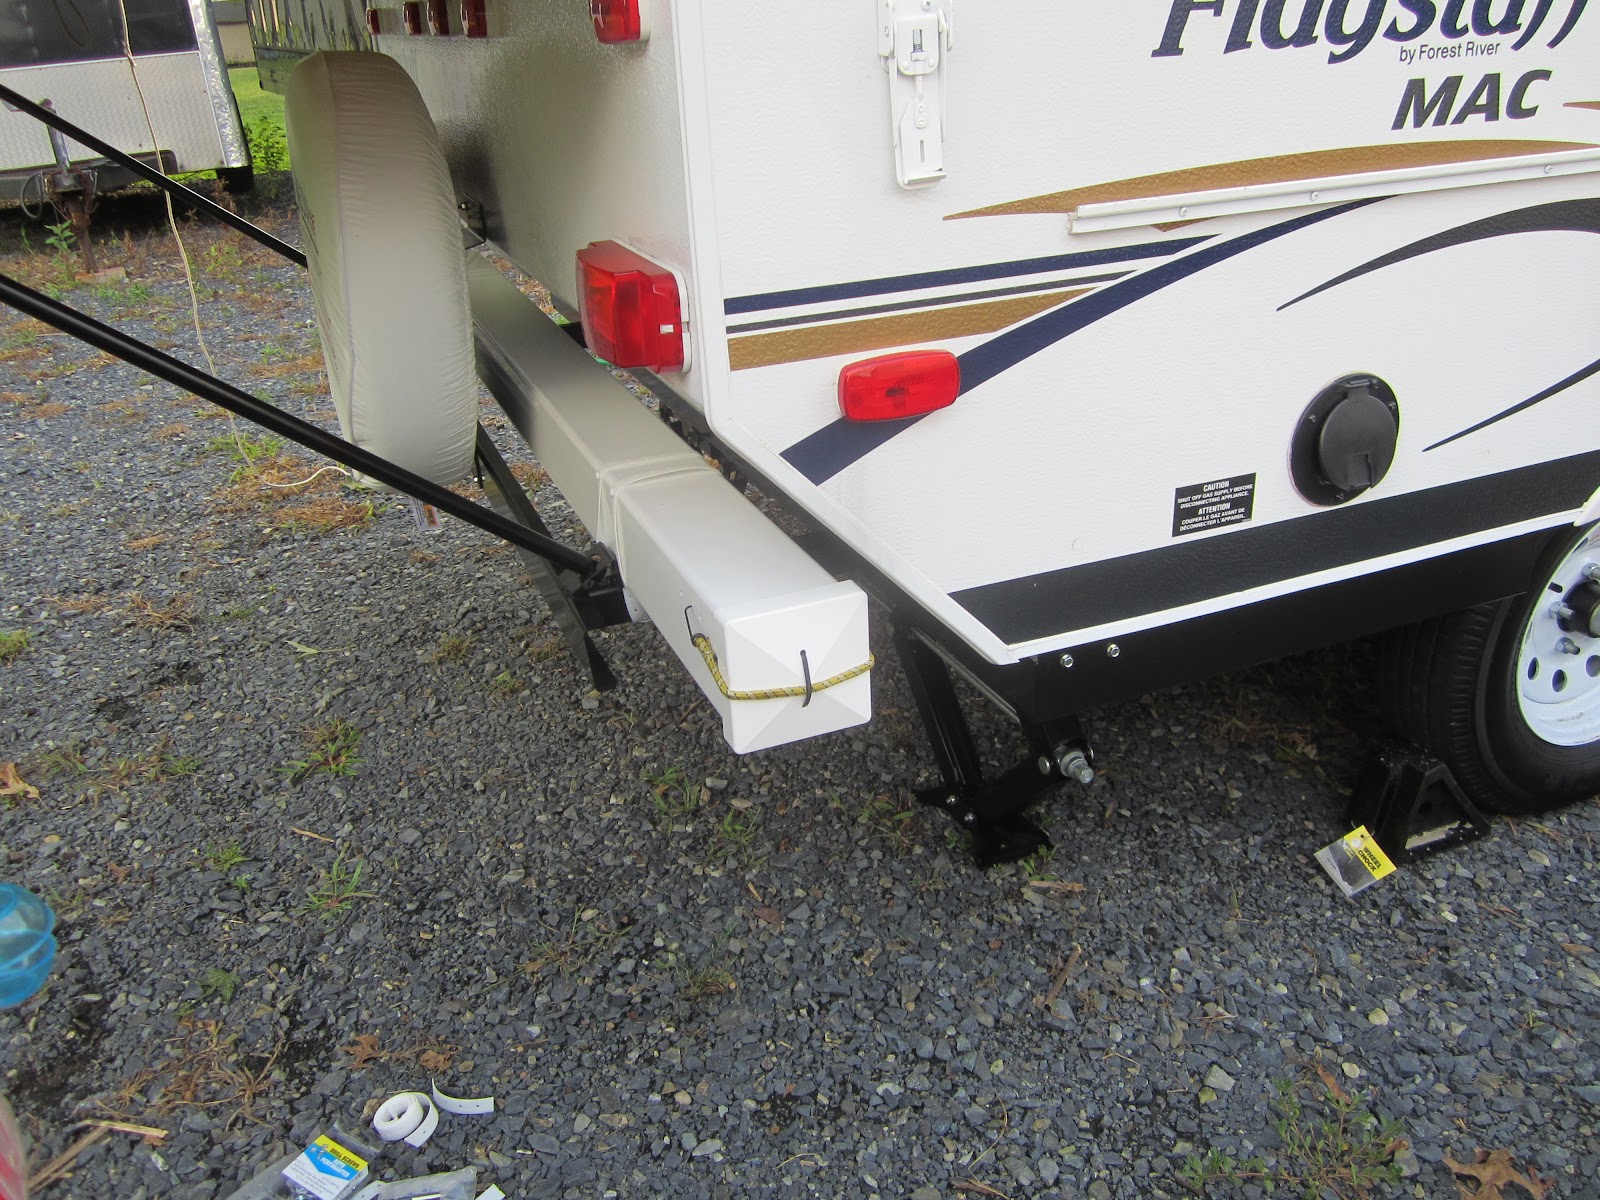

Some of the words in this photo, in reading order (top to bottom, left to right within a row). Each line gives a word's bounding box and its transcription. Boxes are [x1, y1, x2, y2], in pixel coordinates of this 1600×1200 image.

[1399, 46, 1416, 65] by
[1419, 43, 1462, 60] Forest
[1465, 41, 1500, 57] River
[1391, 69, 1552, 130] MAC
[1178, 496, 1191, 504] SHUT
[1202, 491, 1213, 499] GAS
[1214, 488, 1233, 497] SUPPLY
[1234, 484, 1253, 492] BEFORE
[1203, 480, 1229, 492] CAUTION
[1180, 496, 1220, 509] DISCONNECTING
[1198, 502, 1230, 515] ATTENTION
[1181, 516, 1203, 525] COUPER
[1221, 509, 1238, 517] AVANT
[1357, 849, 1377, 872] CHOCK
[1363, 846, 1381, 869] WHEEL
[342, 1155, 360, 1169] SCREWS
